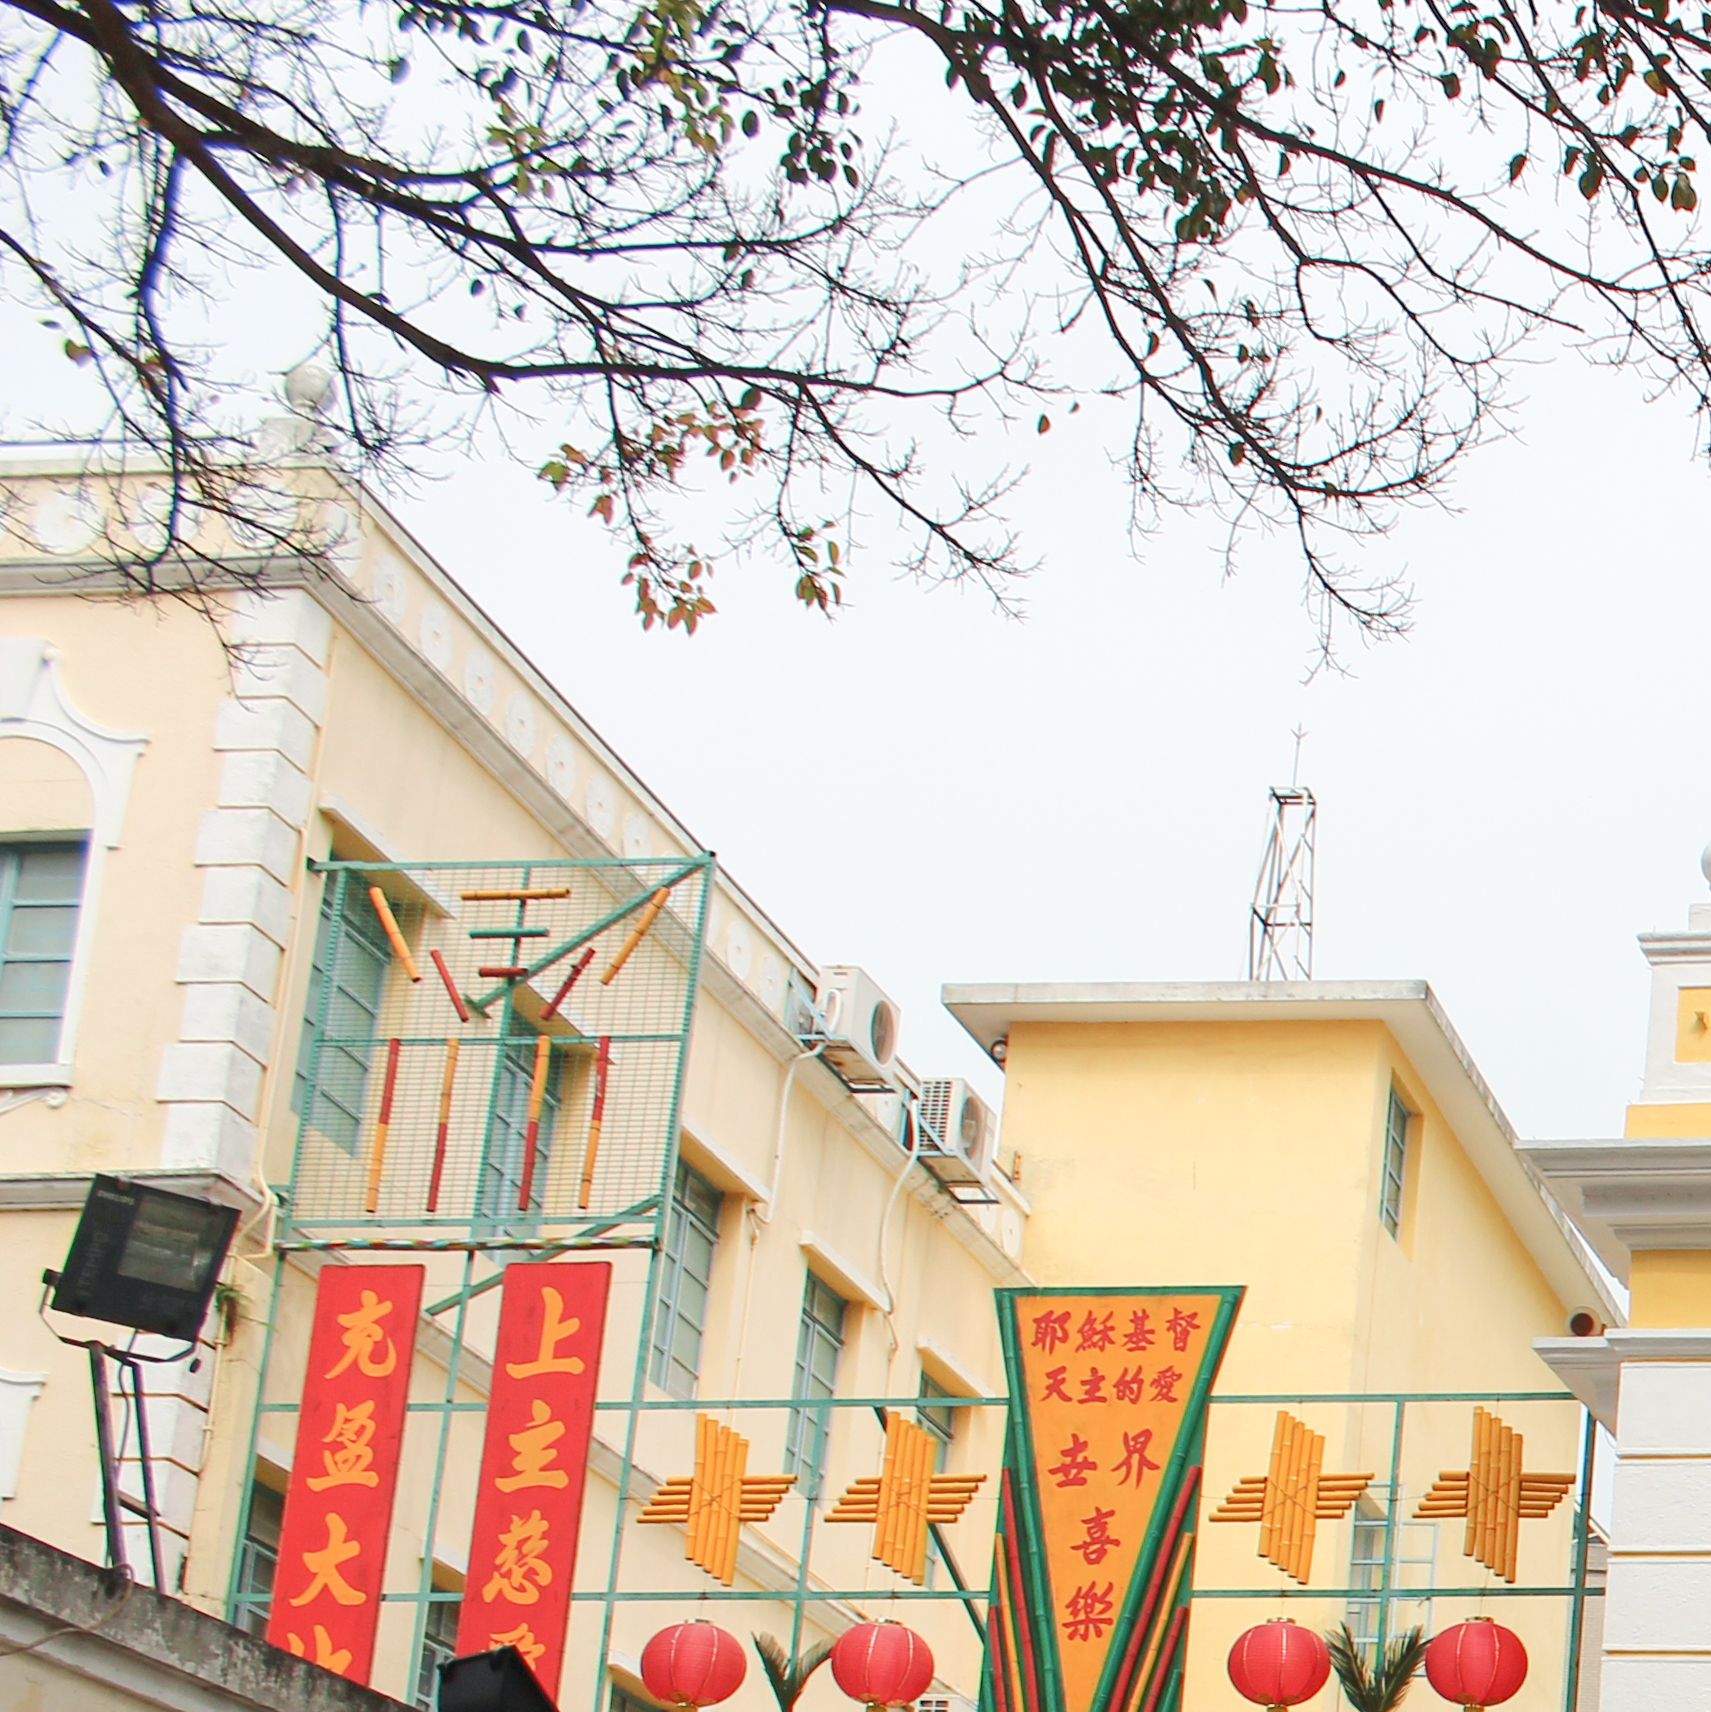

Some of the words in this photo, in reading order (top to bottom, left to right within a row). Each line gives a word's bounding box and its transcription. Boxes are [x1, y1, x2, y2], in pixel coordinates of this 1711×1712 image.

[1031, 1308, 1201, 1355] 耶穌基督
[1040, 1365, 1182, 1404] 天主的愛
